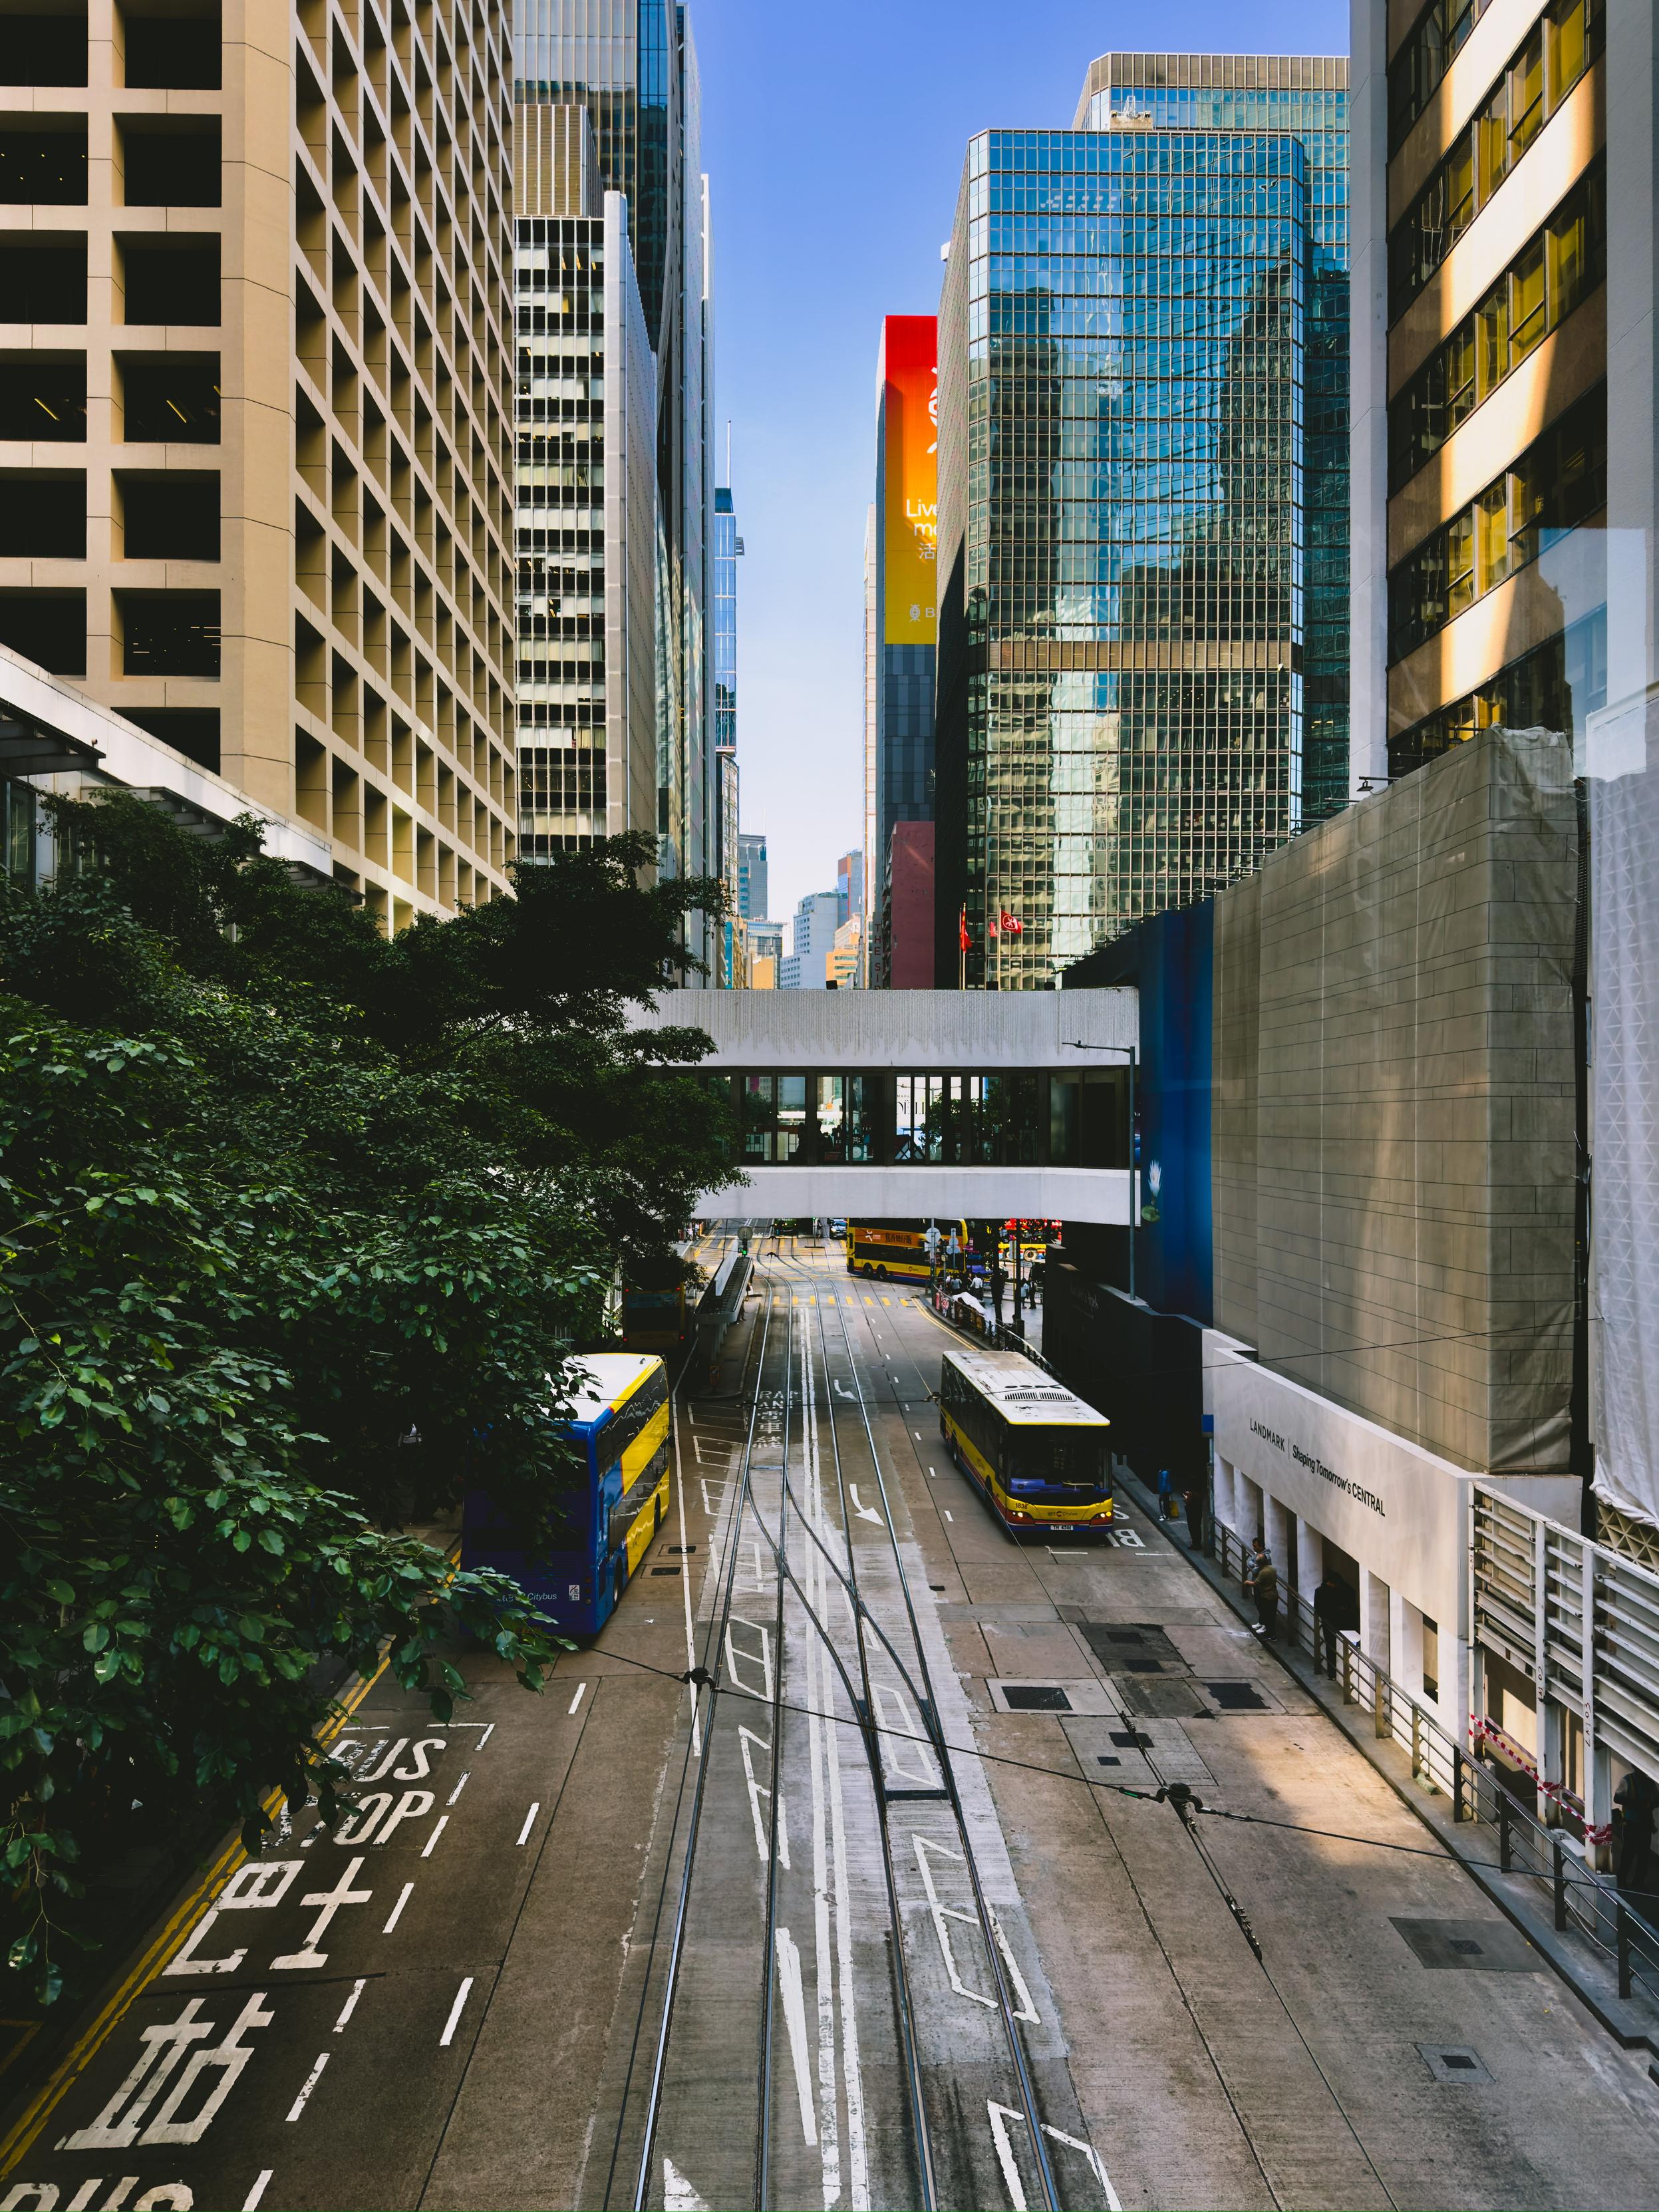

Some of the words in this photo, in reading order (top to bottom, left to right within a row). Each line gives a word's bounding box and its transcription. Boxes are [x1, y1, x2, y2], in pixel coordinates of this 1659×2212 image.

[1250, 1418, 1285, 1452] LANDMARK
[1292, 1444, 1315, 1474] Shaping
[1316, 1459, 1351, 1495] Tomorrow's
[1352, 1483, 1386, 1517] CENTRAL
[527, 1592, 557, 1602] Citybus
[324, 1738, 447, 1782] BUS
[162, 1857, 373, 1976] 巴士
[54, 1992, 275, 2151] 站
